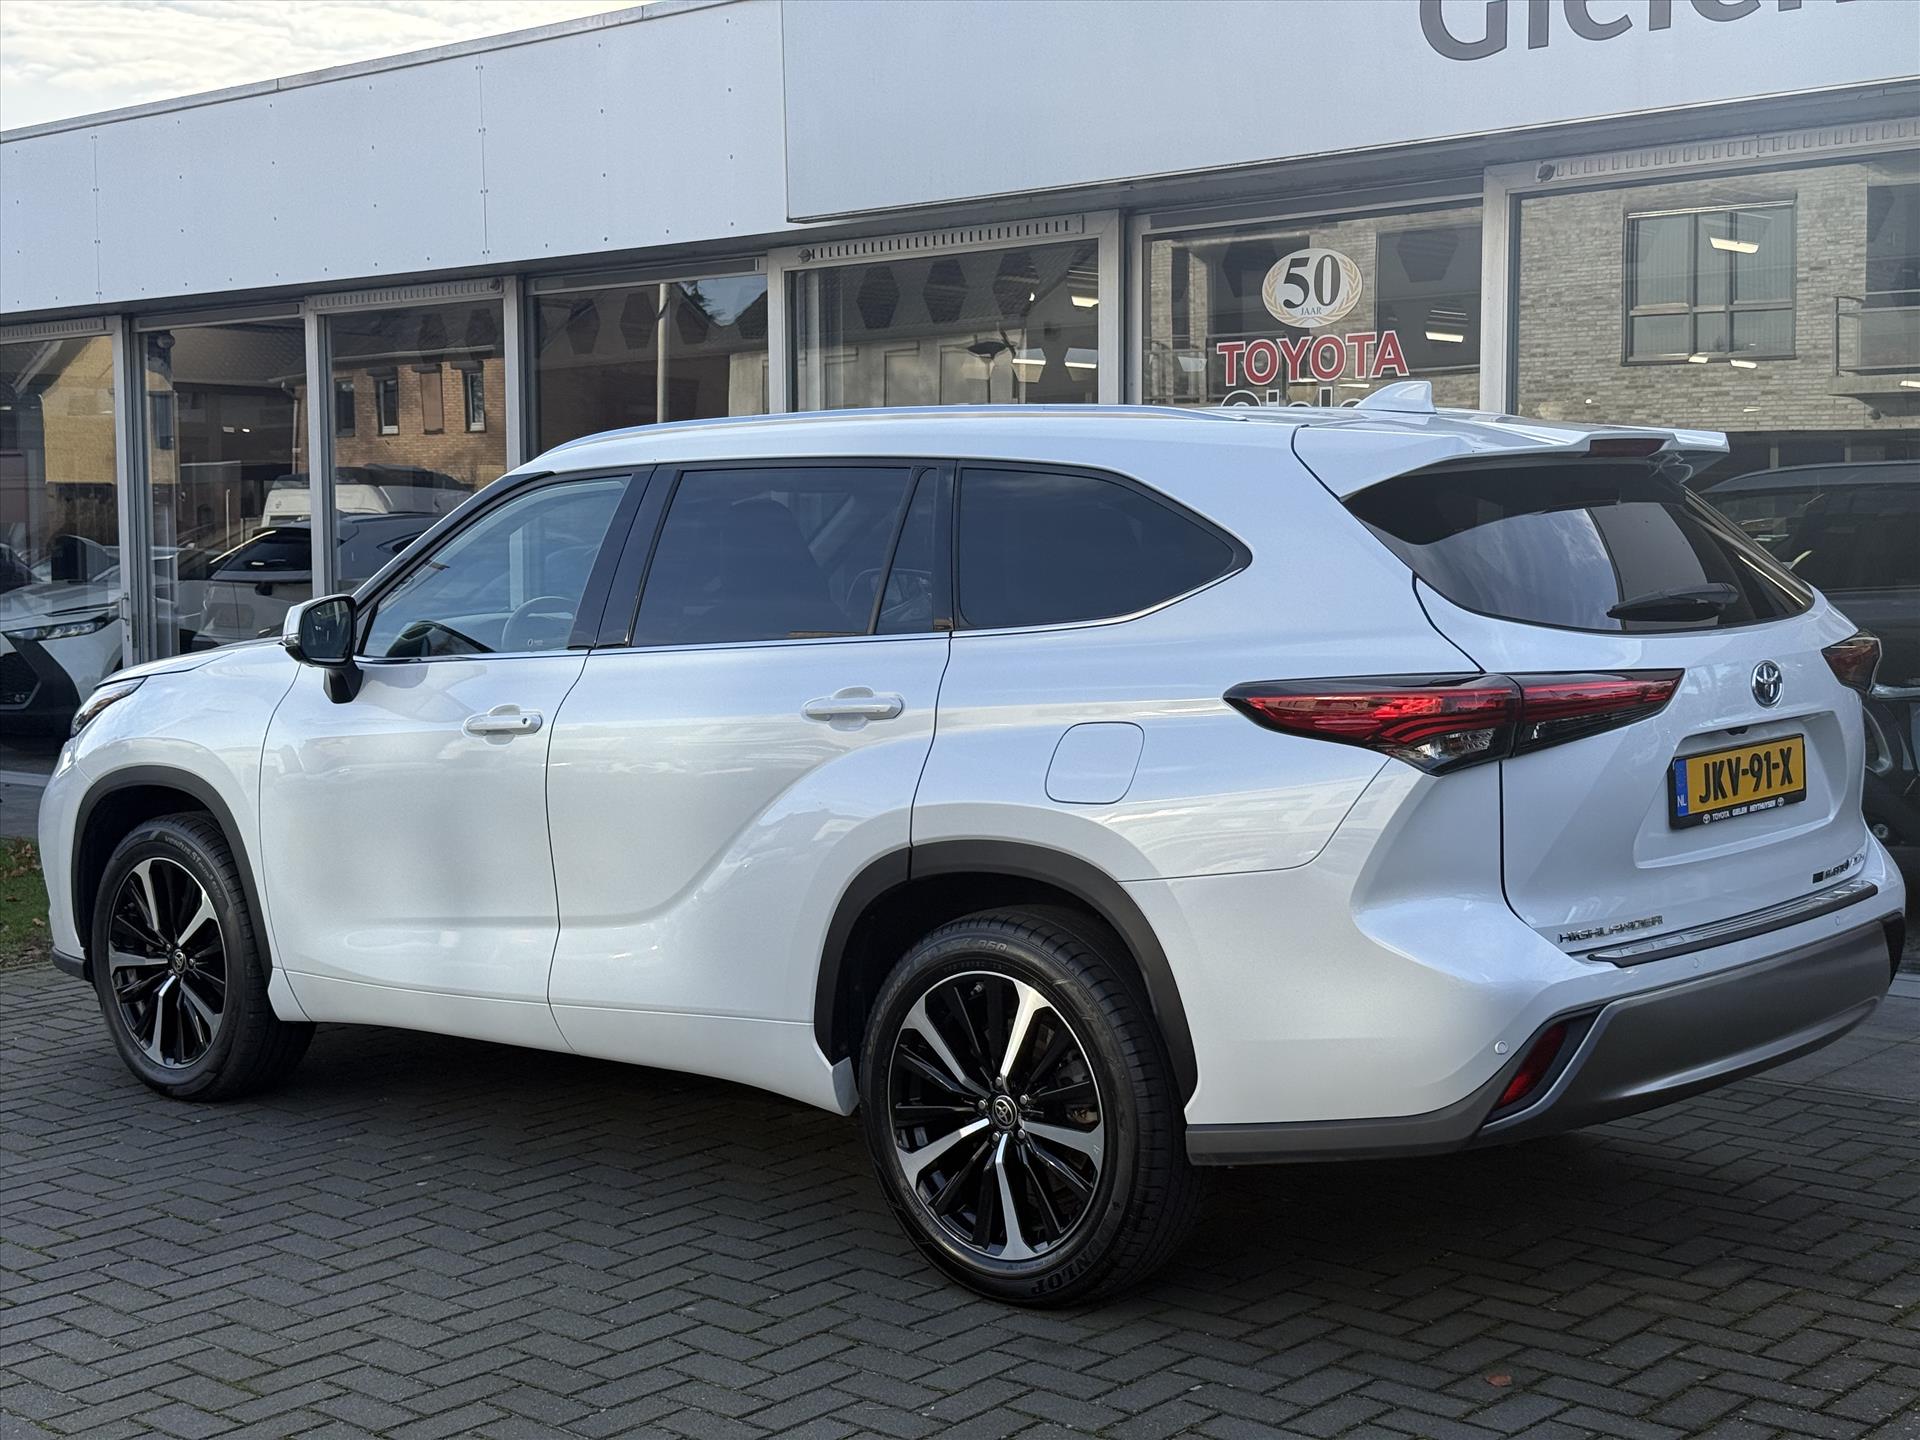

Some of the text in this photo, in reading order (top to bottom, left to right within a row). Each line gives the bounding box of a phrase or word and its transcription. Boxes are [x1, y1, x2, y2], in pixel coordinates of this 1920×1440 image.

[1282, 254, 1341, 309] 50
[1301, 306, 1322, 316] JAAR
[1217, 330, 1409, 387] TOYOTA
[1699, 747, 1793, 803] JKV-91-X
[1677, 794, 1688, 807] NL
[1712, 810, 1730, 821] TOYOTA
[1557, 914, 1664, 943] HIGHLANDER
